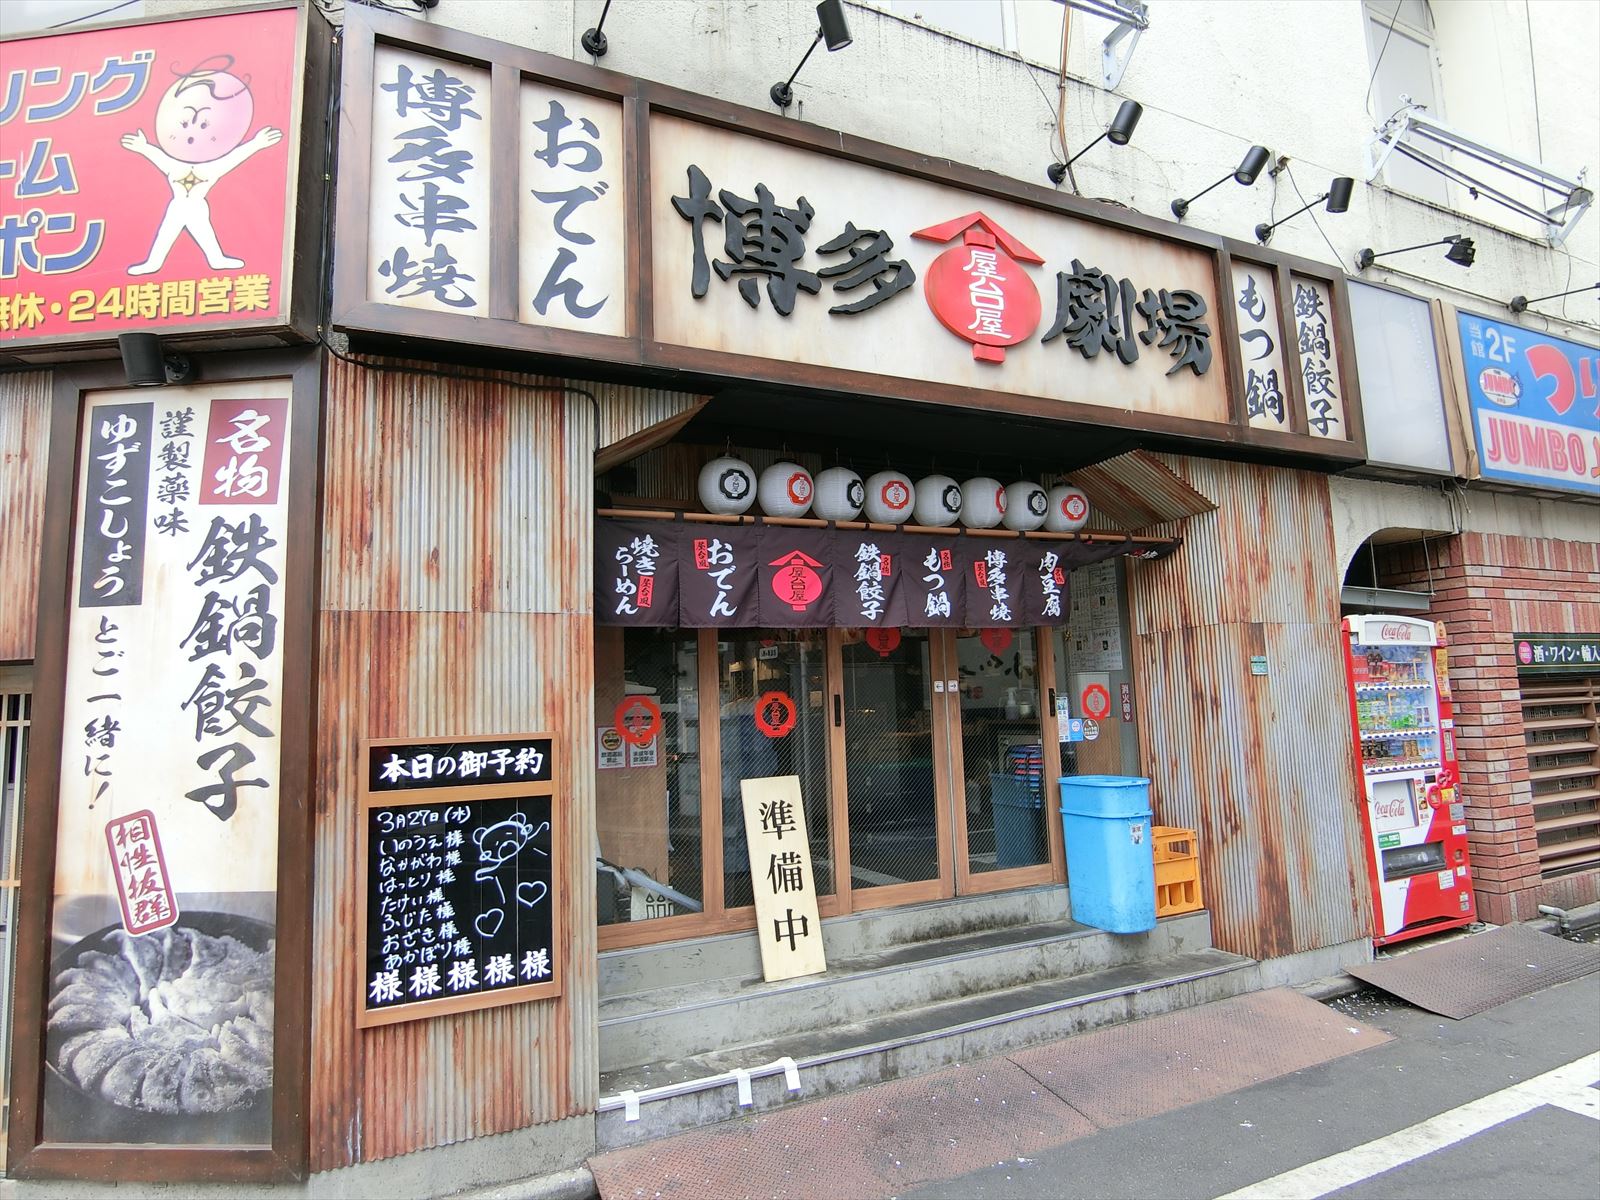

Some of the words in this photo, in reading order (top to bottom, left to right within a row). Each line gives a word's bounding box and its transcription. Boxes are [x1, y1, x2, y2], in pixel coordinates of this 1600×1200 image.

[0, 138, 80, 199] ム
[378, 64, 482, 308] 博多串焼
[531, 100, 609, 319] おでん
[0, 274, 271, 331] 休・24時間営業
[962, 250, 1013, 340] 屋台屋
[1239, 274, 1285, 425] もつ鍋
[1294, 283, 1338, 436] 鉄鍋餃子
[1485, 327, 1516, 364] 2F
[153, 407, 195, 537] 謹製薬味
[214, 409, 271, 498] 名物
[1487, 416, 1586, 476] JUMBO
[93, 413, 141, 598] ゆずこしょう
[615, 546, 639, 615] らーめん
[631, 534, 659, 576] 焼き
[708, 538, 737, 617] おでん
[788, 567, 808, 602] 屋台屋
[854, 543, 885, 620] 鉄鍋餃子
[922, 548, 950, 618] もつ鍋
[985, 550, 1012, 621] 博多串焼
[1039, 551, 1062, 617] 肉豆腐
[179, 513, 278, 822] 鉄鍋餃子
[379, 747, 544, 783] 本日の御予約
[115, 818, 169, 925] 相性抜群
[758, 799, 809, 952] 準備中
